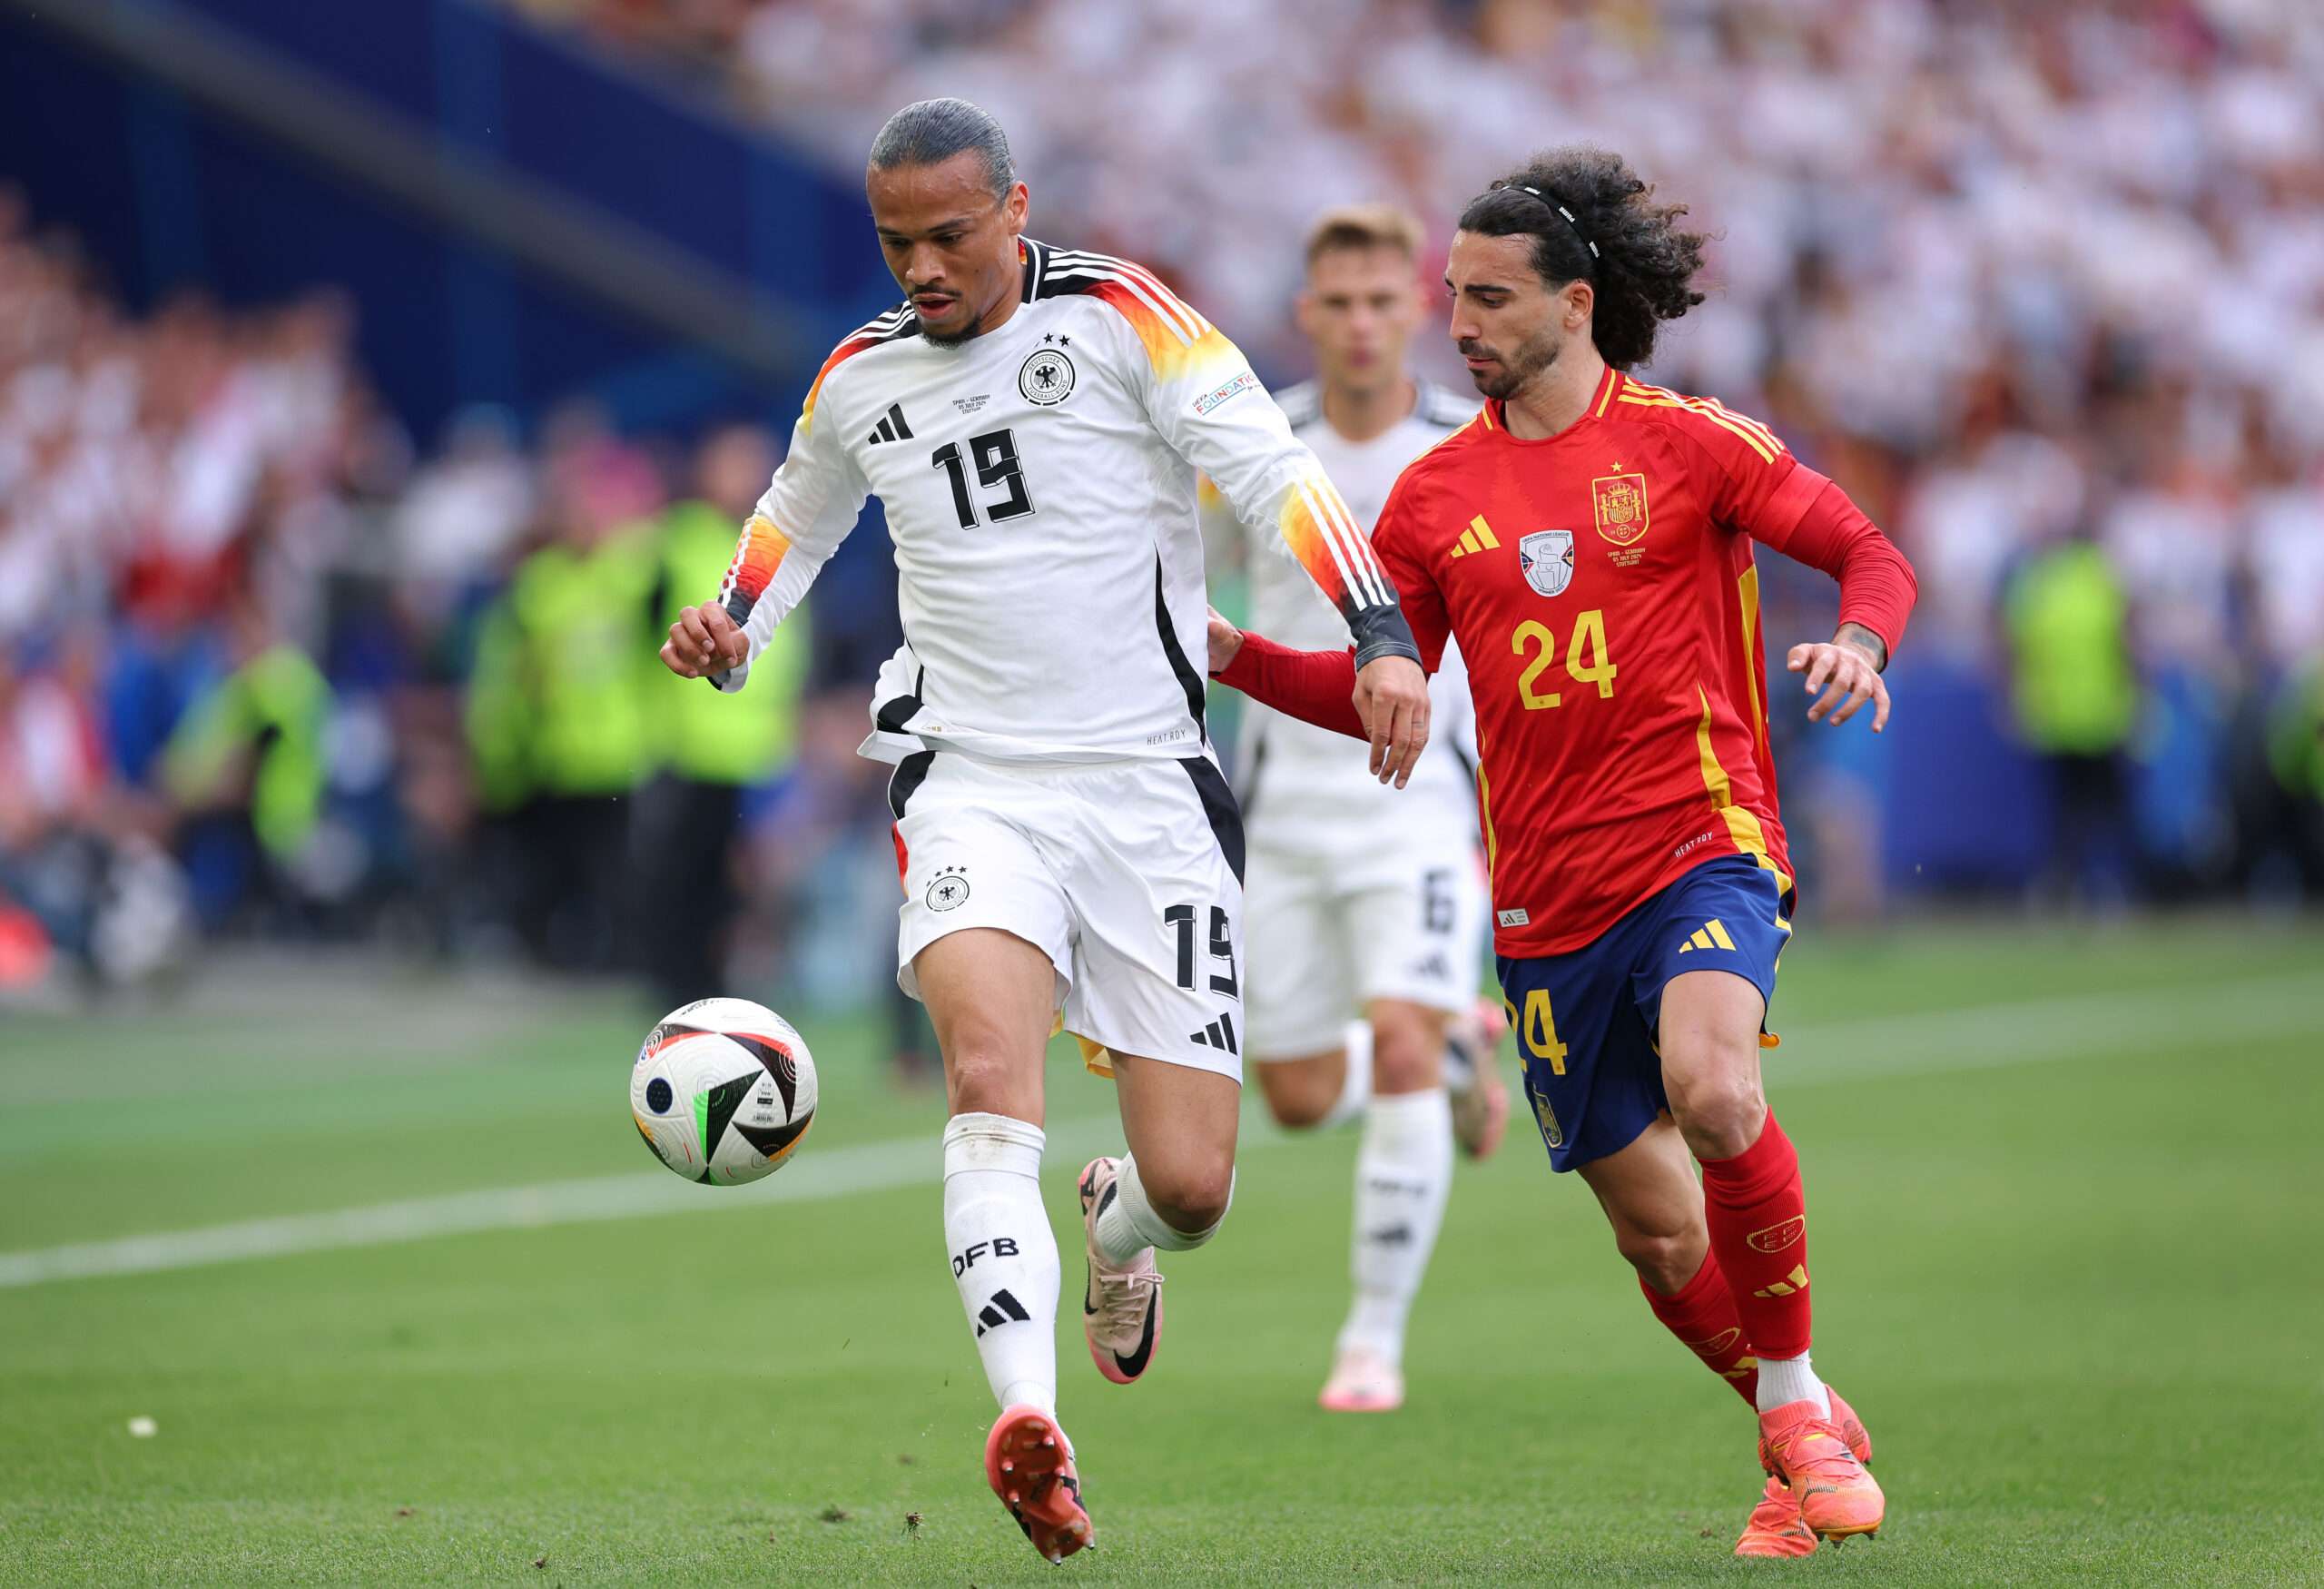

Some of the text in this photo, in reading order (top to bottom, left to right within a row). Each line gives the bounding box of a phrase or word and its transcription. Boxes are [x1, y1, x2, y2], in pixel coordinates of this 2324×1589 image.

[1028, 356, 1060, 371] DEUTSCHER
[1196, 373, 1255, 414] FOUNDATI
[931, 428, 1036, 531] 19
[1512, 609, 1618, 710] 24
[1423, 867, 1454, 935] 6
[1164, 904, 1240, 1003] 19
[952, 1238, 1019, 1279] DFB
